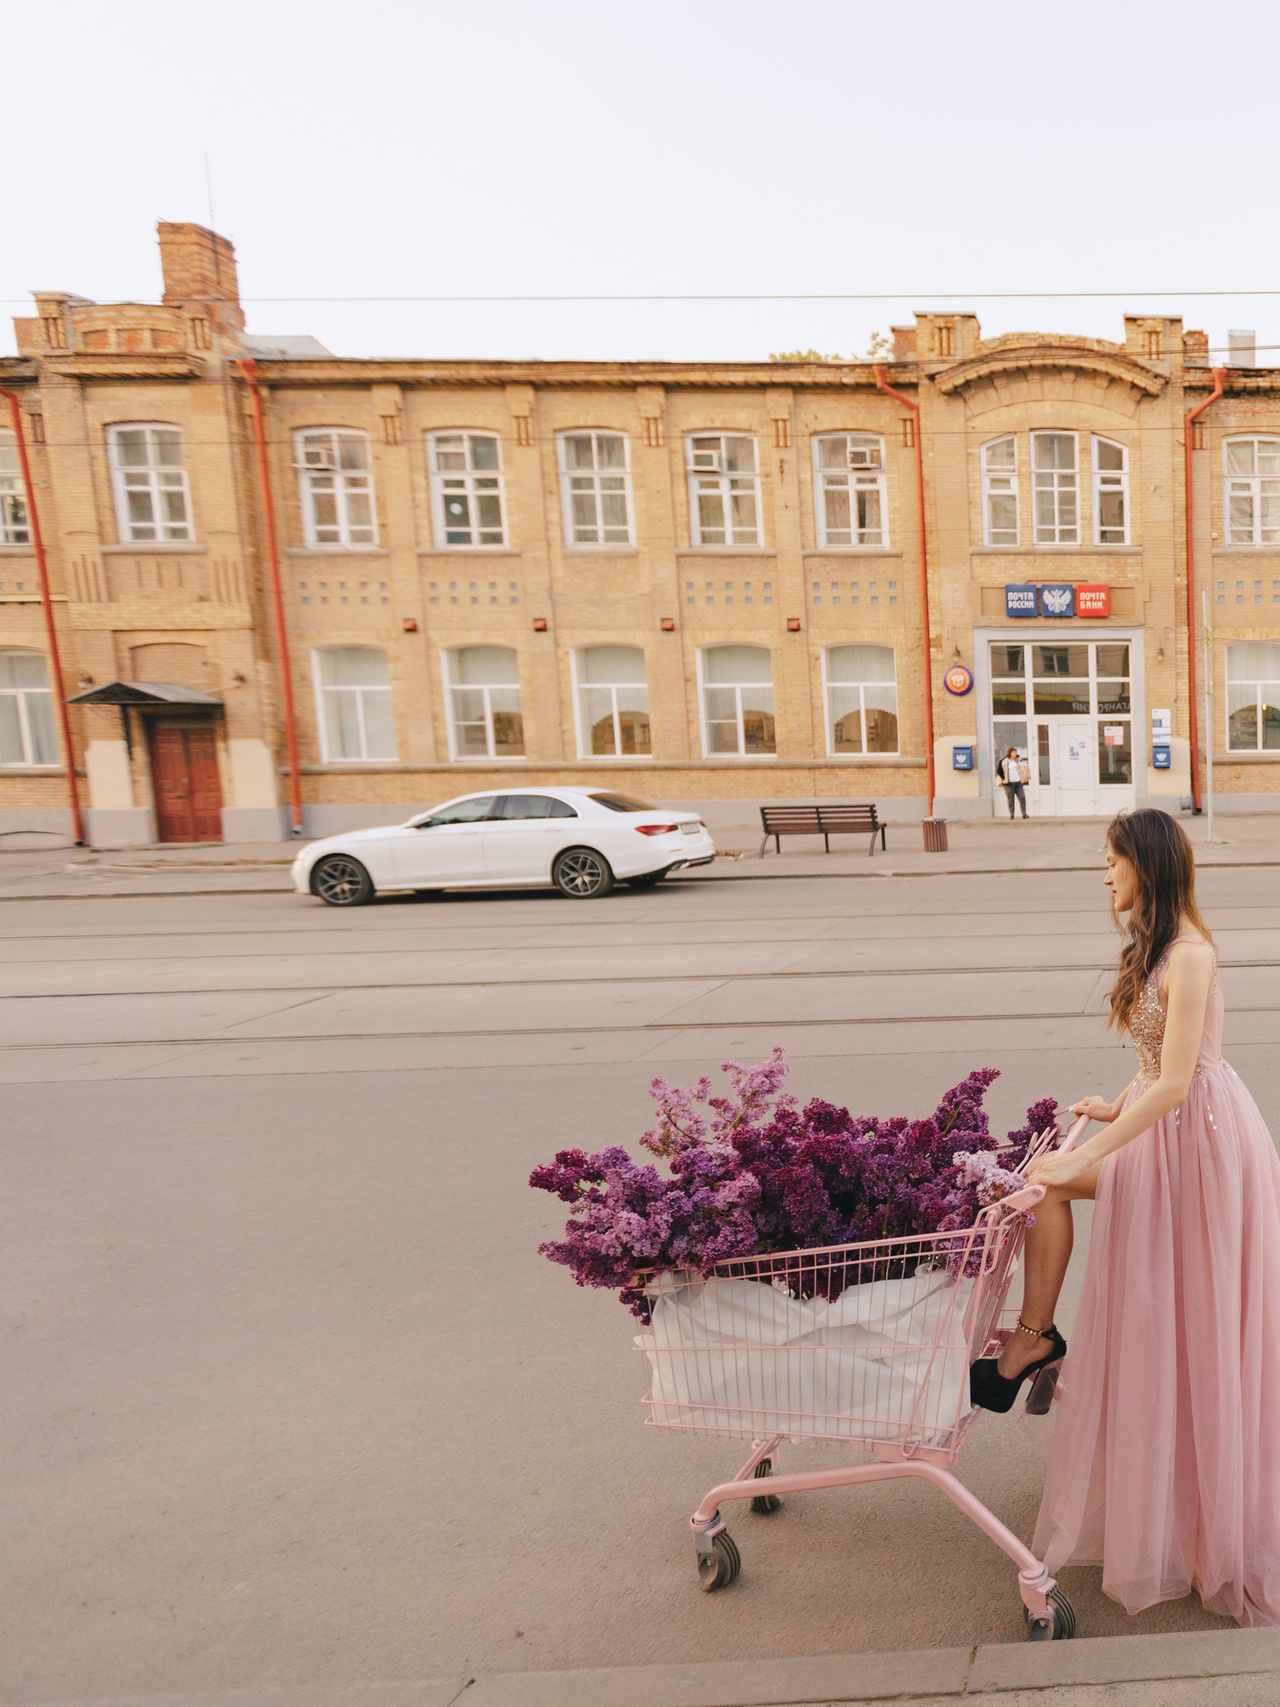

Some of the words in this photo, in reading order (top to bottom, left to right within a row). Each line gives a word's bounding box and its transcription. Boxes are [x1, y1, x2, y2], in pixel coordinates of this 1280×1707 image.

[1008, 592, 1034, 600] ПОЧТА
[1080, 592, 1106, 600] ПОЧТА
[1008, 601, 1034, 609] РОССИИ
[1080, 601, 1103, 609] БАНК
